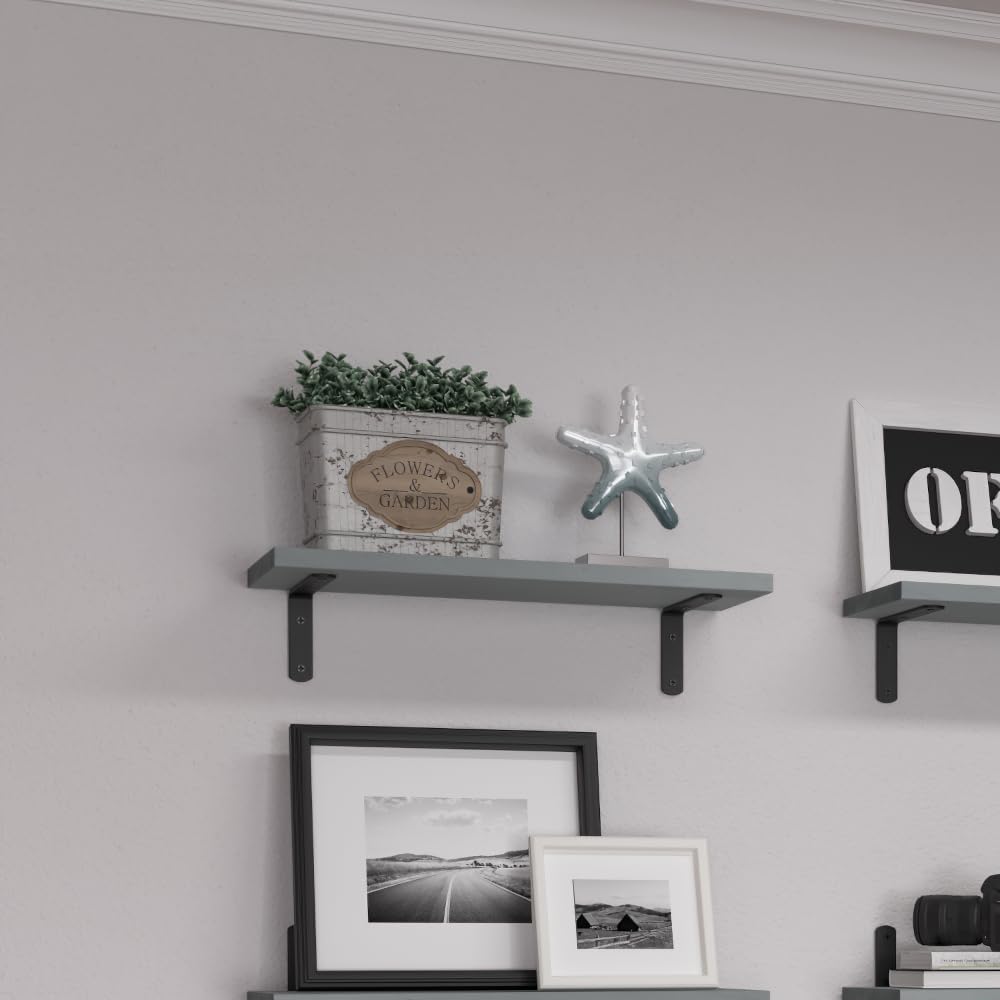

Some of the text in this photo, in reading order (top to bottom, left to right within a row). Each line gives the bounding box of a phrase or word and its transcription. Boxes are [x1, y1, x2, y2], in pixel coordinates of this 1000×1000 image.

[369, 460, 460, 490] FLOWERS
[409, 478, 422, 493] &
[378, 493, 451, 512] GARDEN
